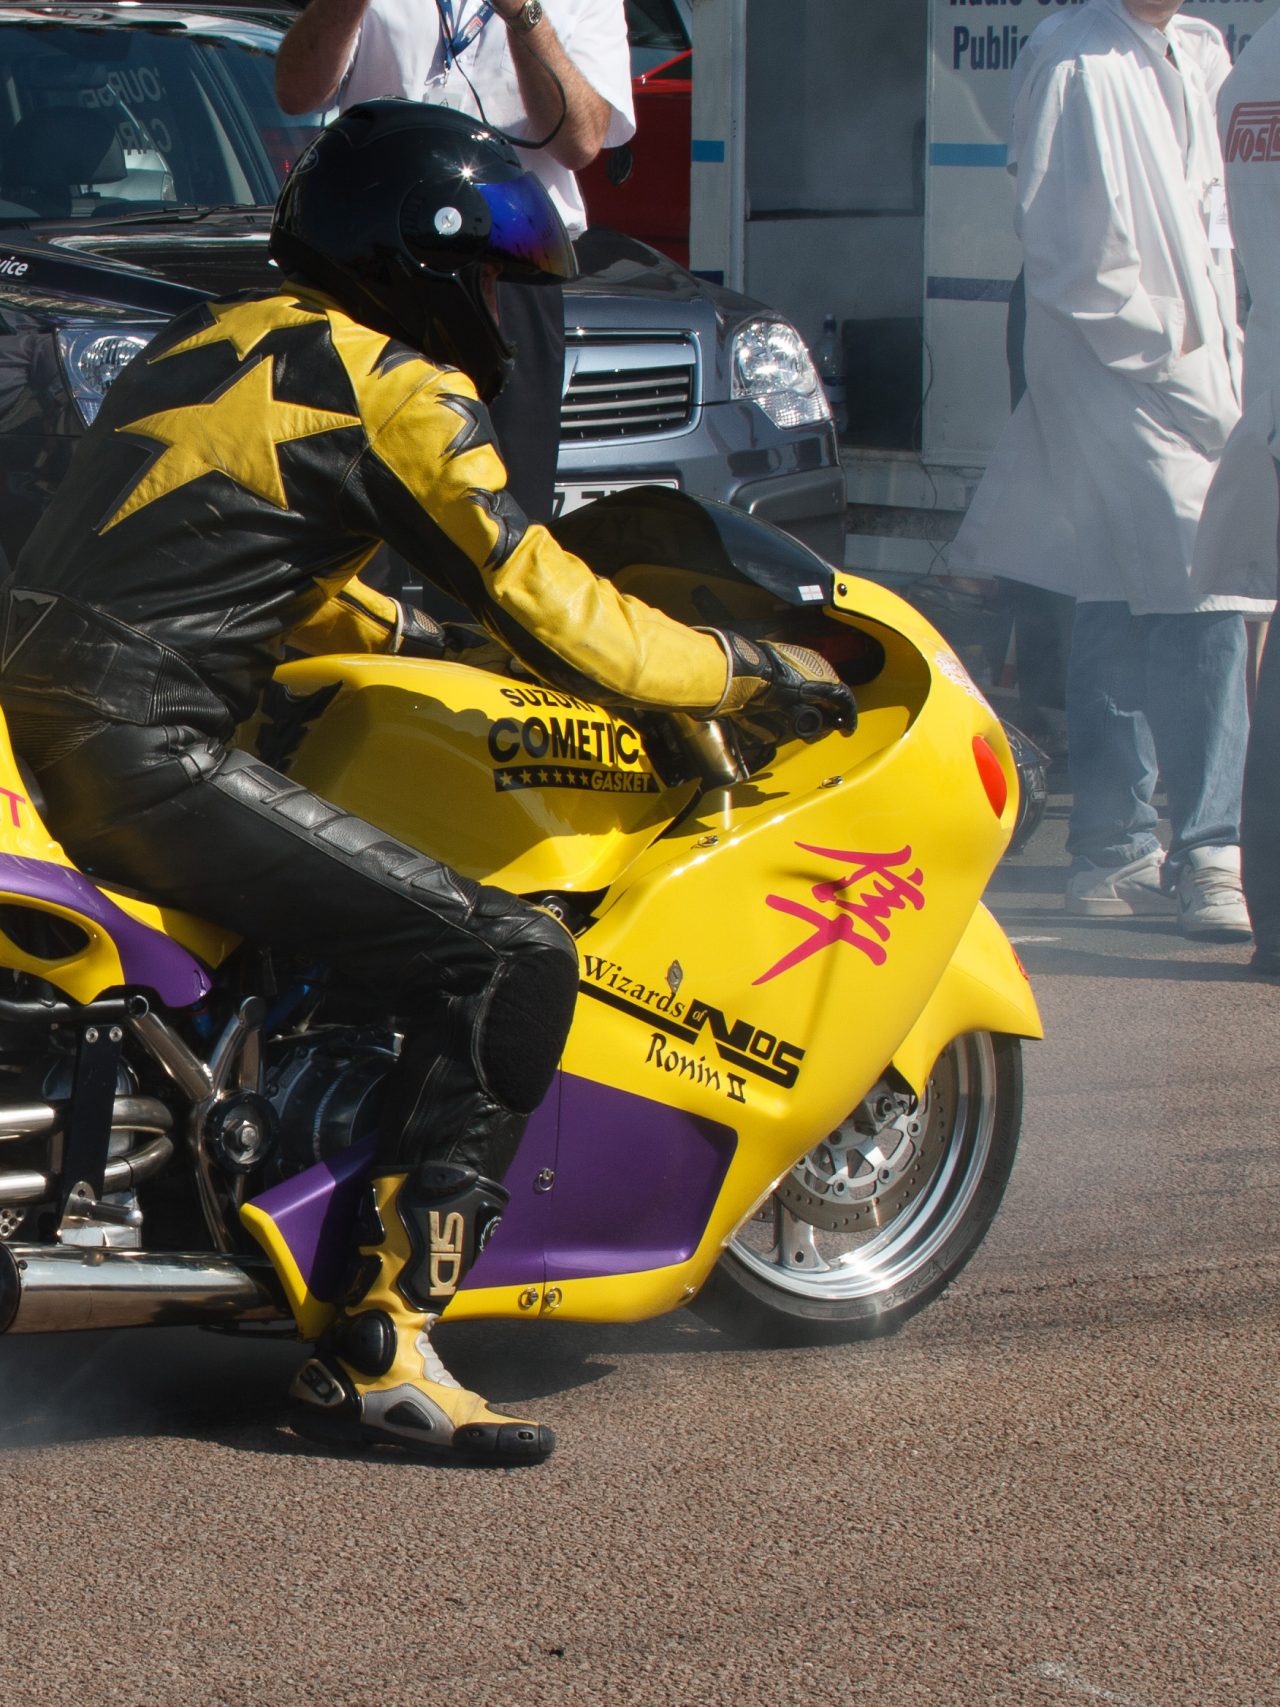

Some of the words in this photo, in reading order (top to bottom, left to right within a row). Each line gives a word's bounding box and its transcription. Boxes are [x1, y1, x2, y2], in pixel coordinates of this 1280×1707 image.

[500, 688, 596, 713] SUZUKI
[488, 716, 639, 764] COMETIC
[591, 771, 651, 792] GASKET
[583, 954, 686, 1019] Wizards
[692, 1009, 707, 1022] of
[645, 1032, 721, 1091] Ronin
[683, 998, 806, 1089] NOS
